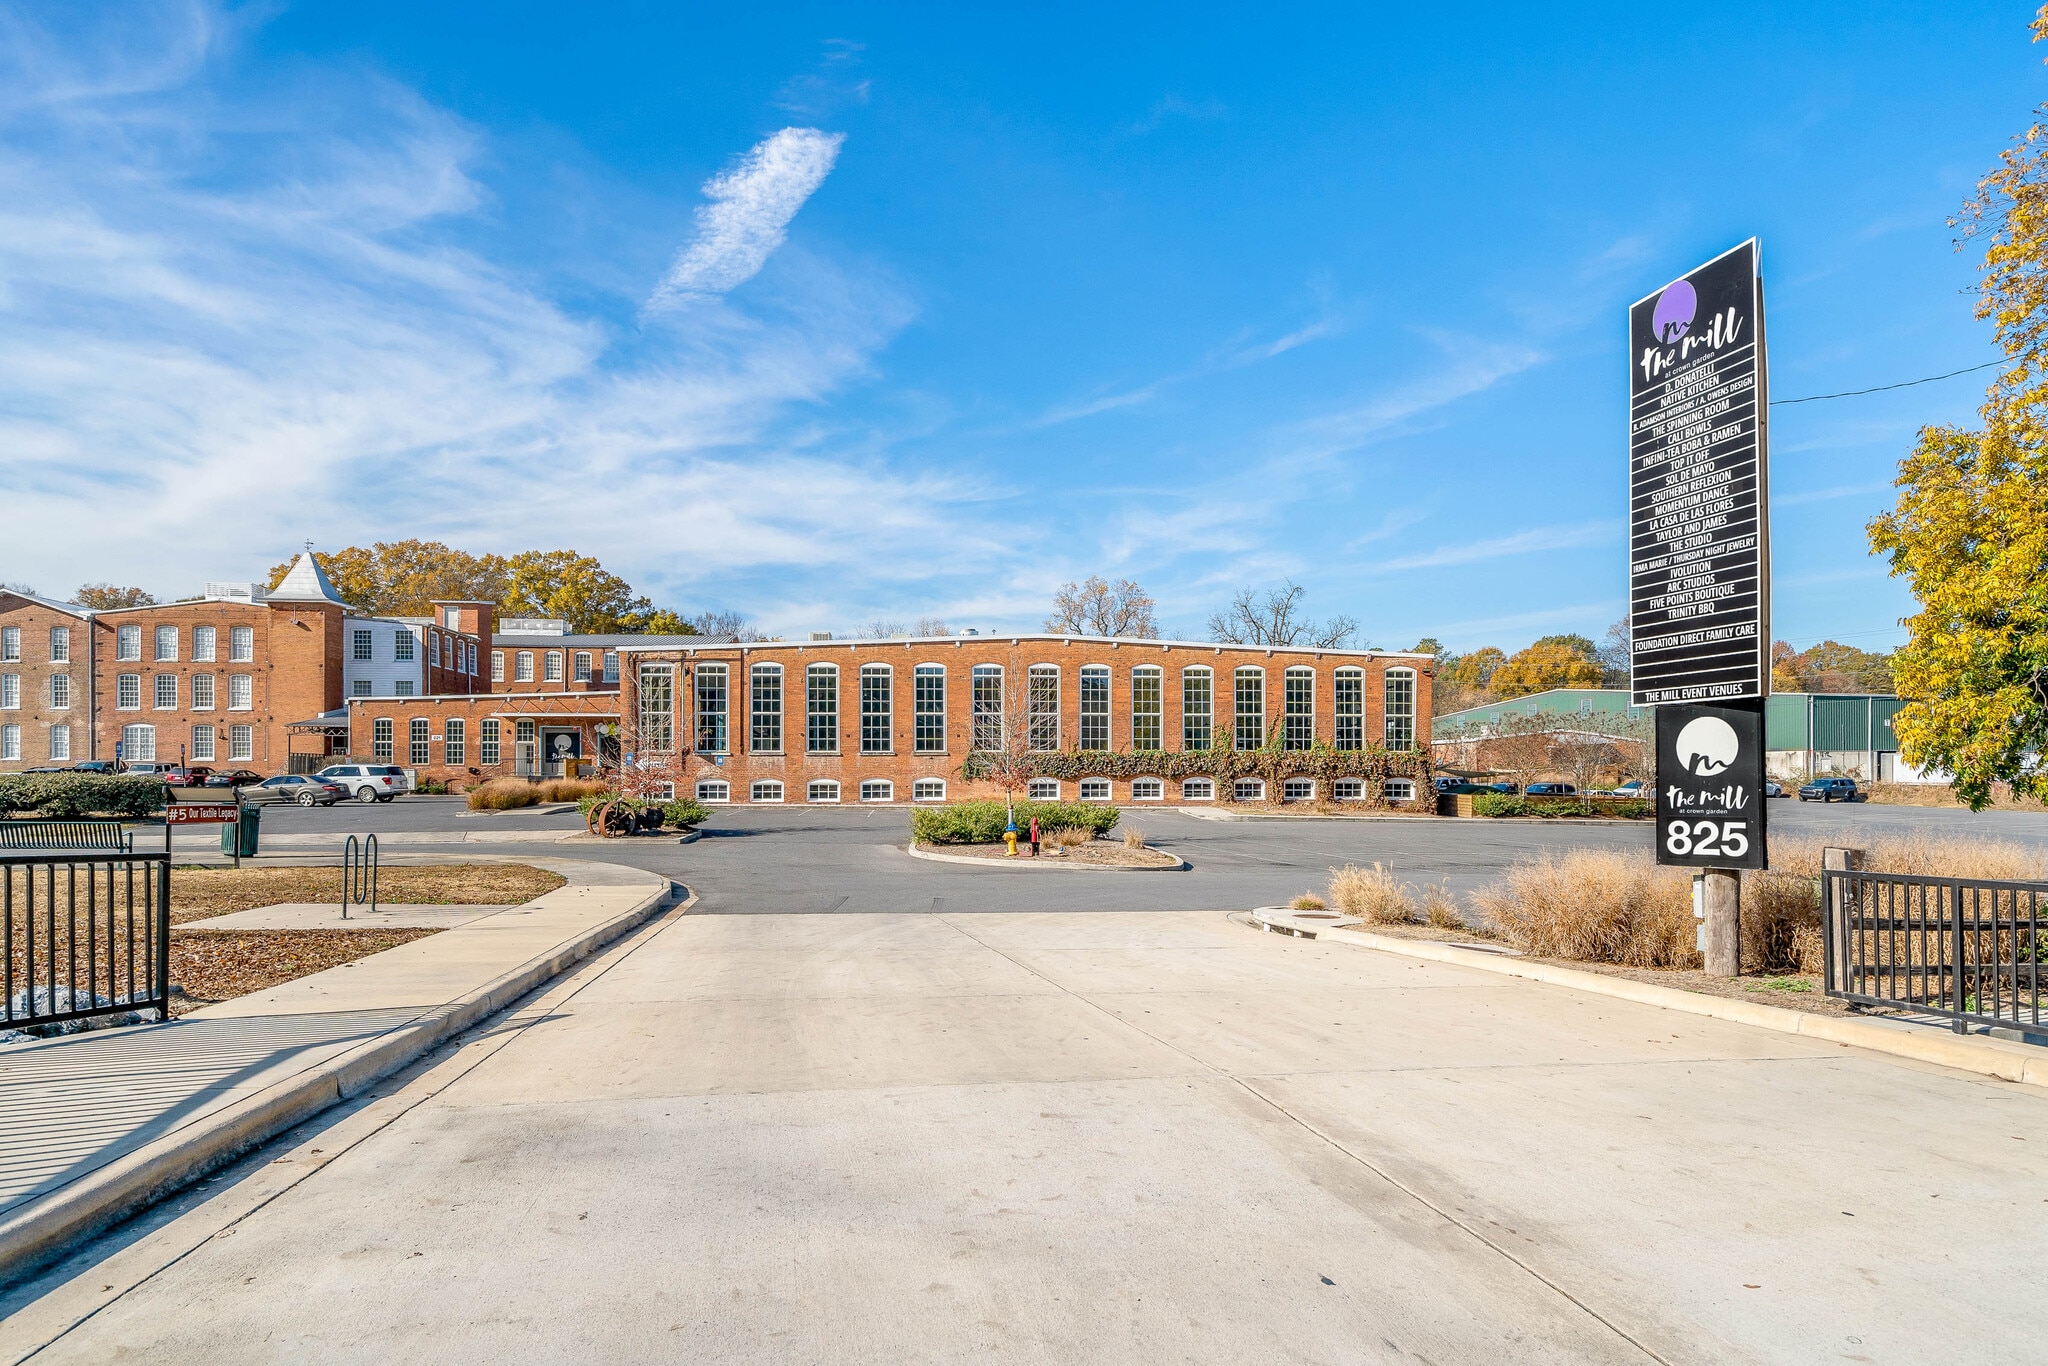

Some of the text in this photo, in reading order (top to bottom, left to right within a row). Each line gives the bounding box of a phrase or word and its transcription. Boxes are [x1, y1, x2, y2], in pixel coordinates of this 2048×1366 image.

[1640, 307, 1743, 382] the mill
[1673, 364, 1690, 375] crown
[1692, 352, 1715, 367] garden
[1660, 375, 1719, 407] NATIVE KITCHEN
[1666, 364, 1714, 393] D. DONATELLI
[1640, 412, 1665, 428] ADAMSON
[1666, 400, 1694, 417] INTERIORS
[1708, 386, 1728, 400] OWENS
[1730, 377, 1752, 392] DESIGN
[1652, 399, 1730, 437] THE SPINNING ROOM
[1643, 424, 1740, 467] INFINI-TEA BOBA & RAMEN
[1668, 420, 1712, 444] CALI BOWLS
[1670, 449, 1710, 470] TOP IT OFF
[1652, 470, 1731, 503] SOUTHERN REFLEXION
[1666, 462, 1714, 486] SOL DE MAYO
[1650, 498, 1734, 530] LA CASA DE LAS FLORES
[1655, 485, 1729, 516] MOMENTUM DANCE
[1656, 515, 1727, 542] TAYLOR AND JAMES
[1633, 563, 1648, 573] IRMA
[1649, 558, 1668, 570] MARIE
[1673, 548, 1704, 564] THURSDAY
[1705, 544, 1726, 556] NIGHT
[1726, 537, 1755, 553] JEWELRY
[1669, 533, 1712, 552] THE STUDIO
[1667, 574, 1715, 592] ARC STUDIOS
[1670, 561, 1711, 578] IVOLUTION
[1650, 584, 1735, 609] FIVE POINTS BOUTIQUE
[1668, 602, 1714, 619] TRINITY BBQ
[1635, 624, 1755, 651] FOUNDATION DIRECT FAMILY CARE
[1645, 684, 1742, 702] THE MILL EVENT VENUES
[1666, 785, 1749, 809] the mill
[169, 808, 237, 820] #5 Our Textile Legacy
[1666, 820, 1749, 857] 825
